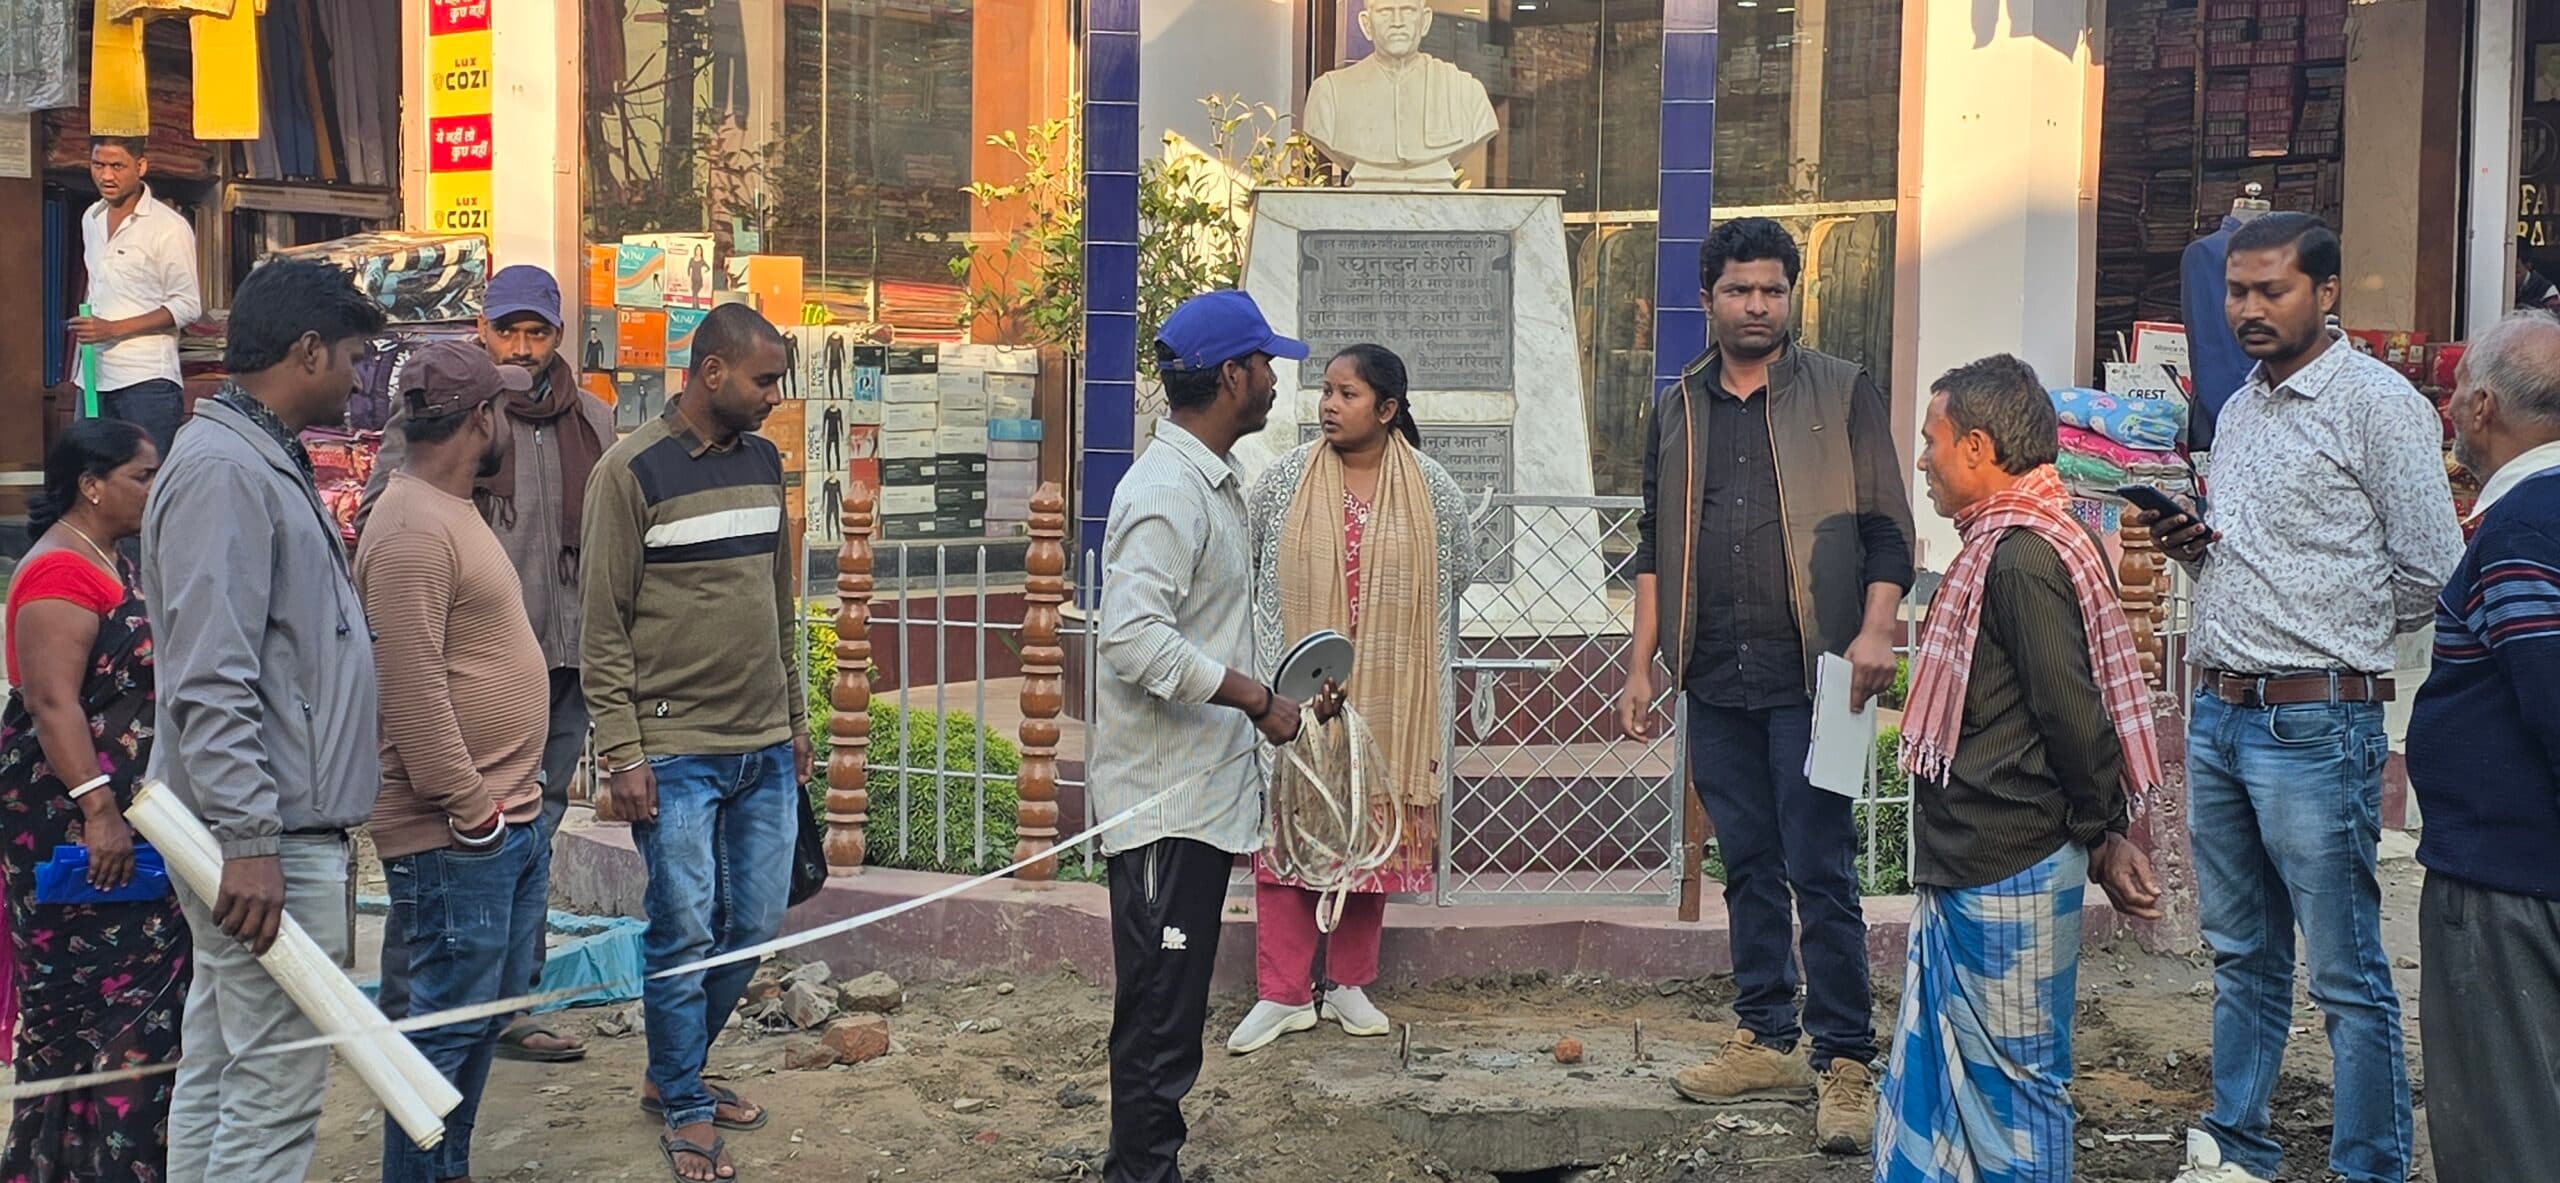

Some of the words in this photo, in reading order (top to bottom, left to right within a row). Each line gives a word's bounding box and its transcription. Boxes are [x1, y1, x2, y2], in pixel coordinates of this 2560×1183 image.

[455, 58, 477, 68] LUX
[446, 70, 487, 91] COZI
[456, 197, 478, 206] LUX
[447, 210, 488, 229] COZI
[1337, 256, 1418, 279] रघुनन्दन
[1421, 250, 1475, 273] केशरी
[1455, 352, 1504, 369] परिवार
[810, 354, 818, 387] FORCE
[2128, 389, 2167, 400] CREST
